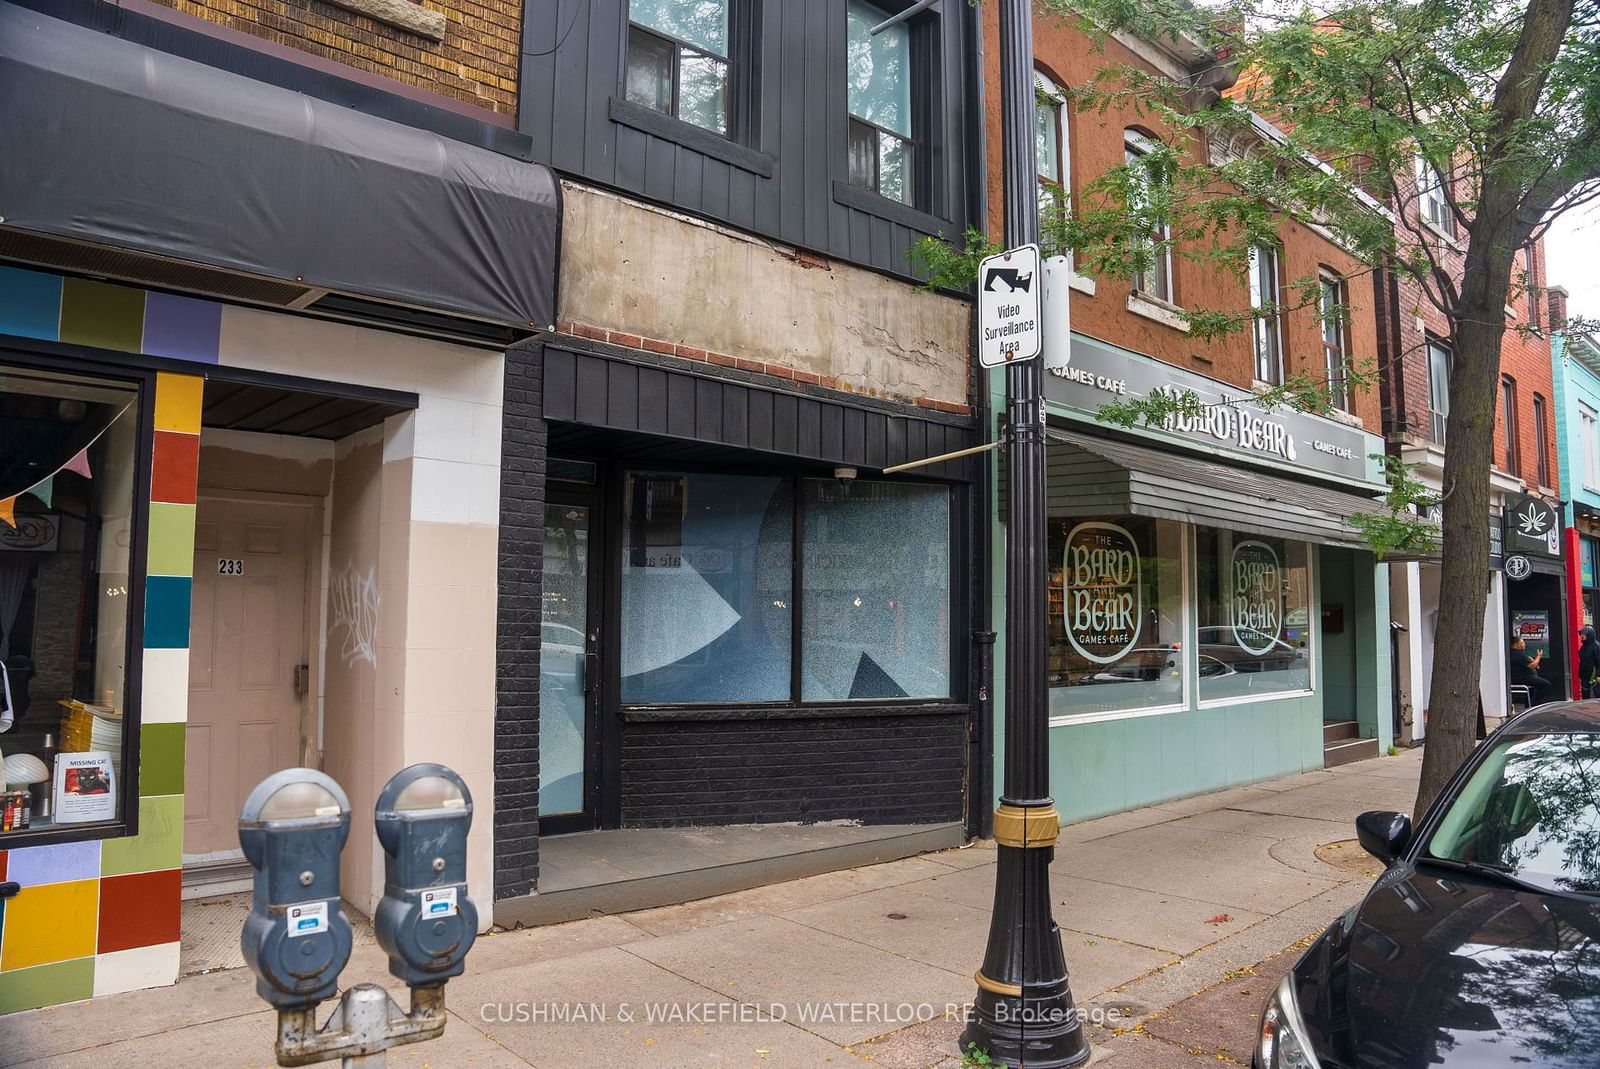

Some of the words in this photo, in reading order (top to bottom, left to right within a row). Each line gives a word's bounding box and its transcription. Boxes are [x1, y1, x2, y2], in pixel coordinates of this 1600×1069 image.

[998, 304, 1020, 319] Video
[985, 319, 1034, 341] Surveillance
[1000, 340, 1020, 354] Area
[1052, 366, 1094, 386] GAMES
[1097, 375, 1126, 395] CAFÉ
[1223, 393, 1241, 409] THE
[1238, 409, 1287, 459] BEAR
[1313, 440, 1335, 455] GAMES
[1336, 446, 1352, 459] CAFÉ
[1095, 535, 1112, 546] THE
[219, 559, 243, 574] 233
[1071, 545, 1133, 587] BARD
[1235, 560, 1275, 593] BARD
[1073, 590, 1134, 631] BEAR
[1236, 596, 1277, 630] BEAR
[1079, 634, 1107, 645] GAMES
[1109, 633, 1129, 644] CAFÉ
[1241, 631, 1259, 640] GAMES
